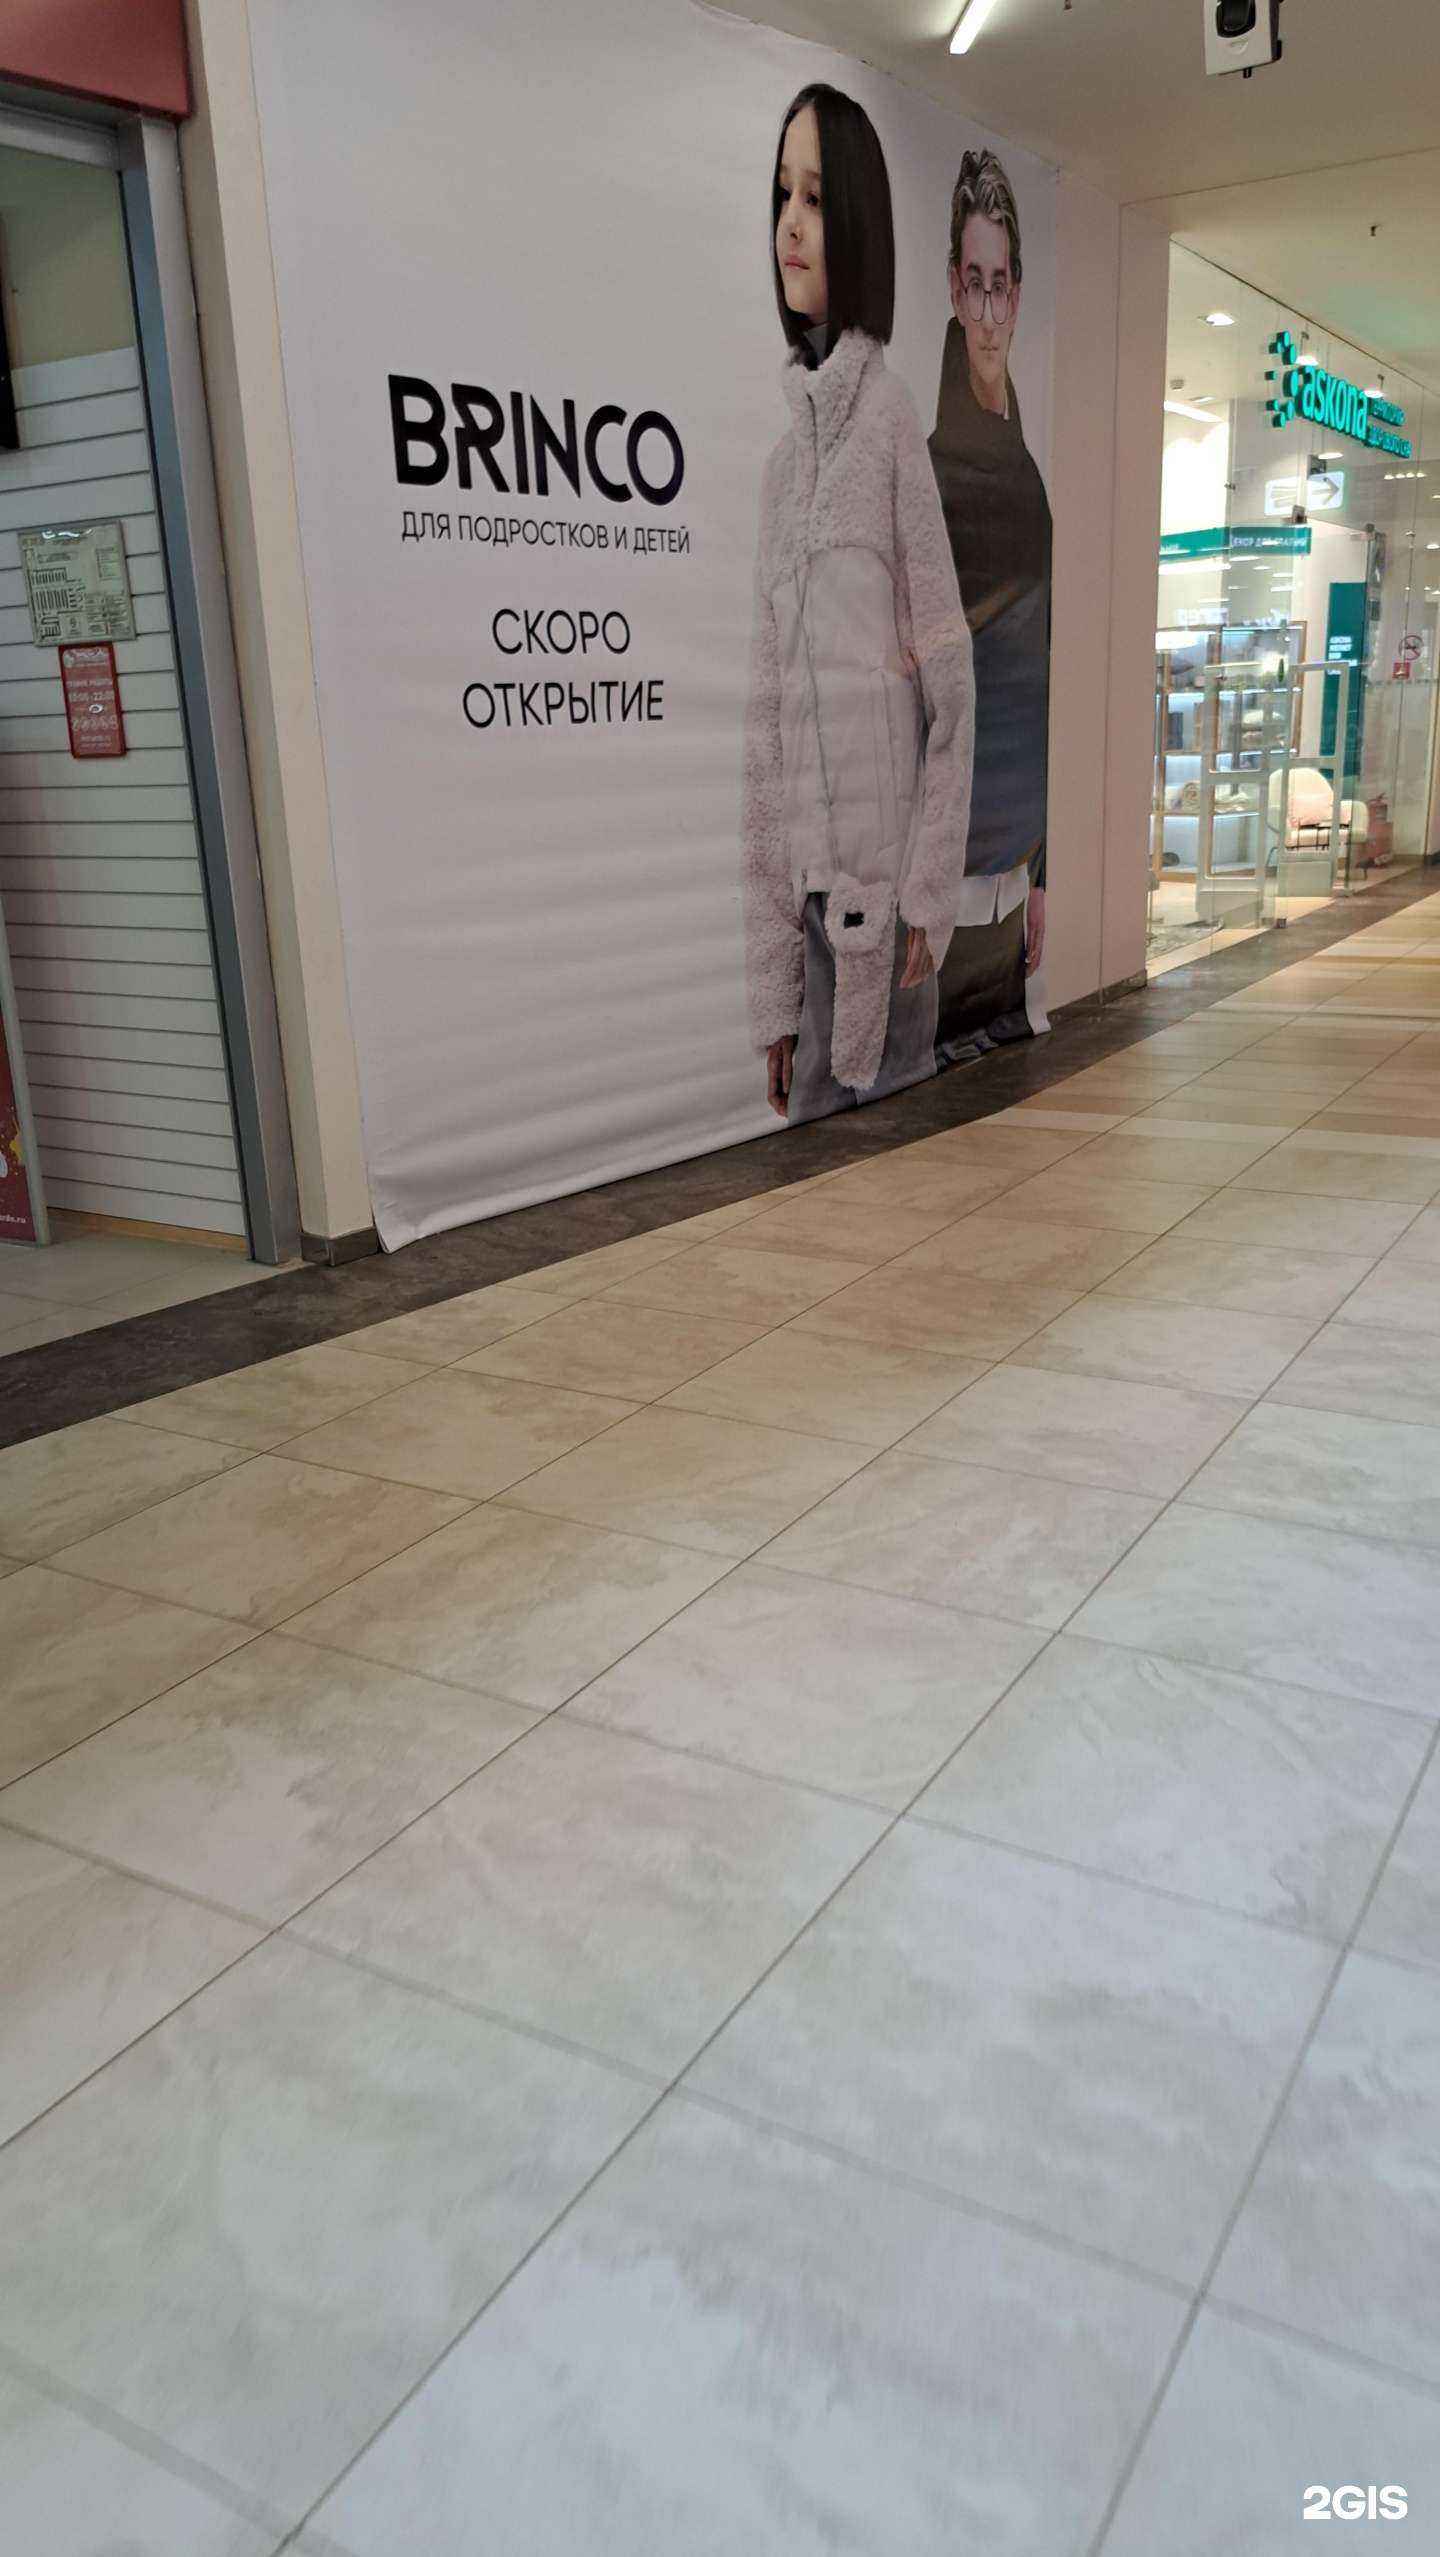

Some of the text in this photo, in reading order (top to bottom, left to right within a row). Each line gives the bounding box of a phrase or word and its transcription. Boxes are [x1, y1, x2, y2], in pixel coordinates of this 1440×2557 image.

[1302, 364, 1368, 441] askona
[388, 374, 685, 506] BRINCO
[402, 511, 691, 555] ДЛЯ ПОДРОСТКОВ И ДЕТЕЙ
[492, 608, 631, 655] СКОРО
[462, 679, 665, 729] ОТКРЫТИЕ
